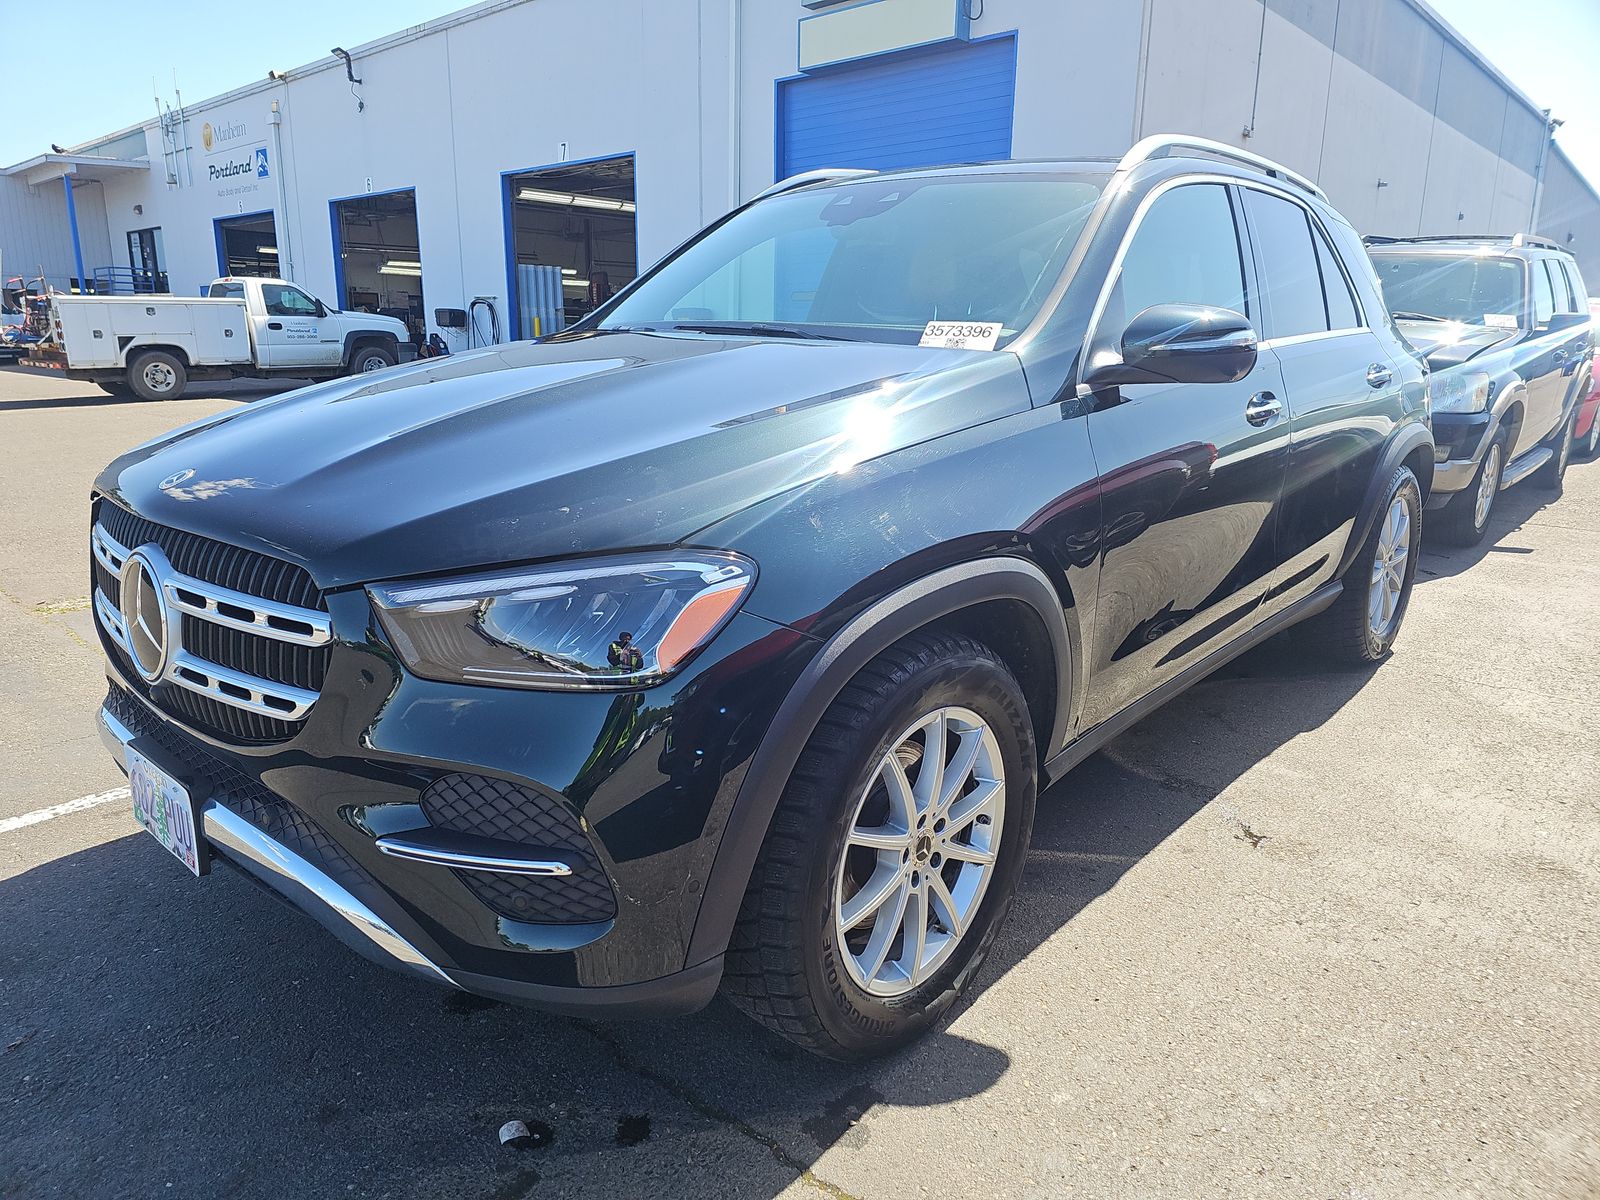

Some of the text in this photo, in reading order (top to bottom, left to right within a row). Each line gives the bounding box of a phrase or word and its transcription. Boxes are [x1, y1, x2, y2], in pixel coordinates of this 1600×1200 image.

[213, 120, 247, 142] Manheim
[560, 143, 567, 161] 7
[208, 155, 252, 181] Portland
[366, 178, 372, 192] 6
[924, 324, 993, 339] 3573396
[163, 791, 192, 850] PUU
[822, 936, 896, 1032] BRIDGESTONE
